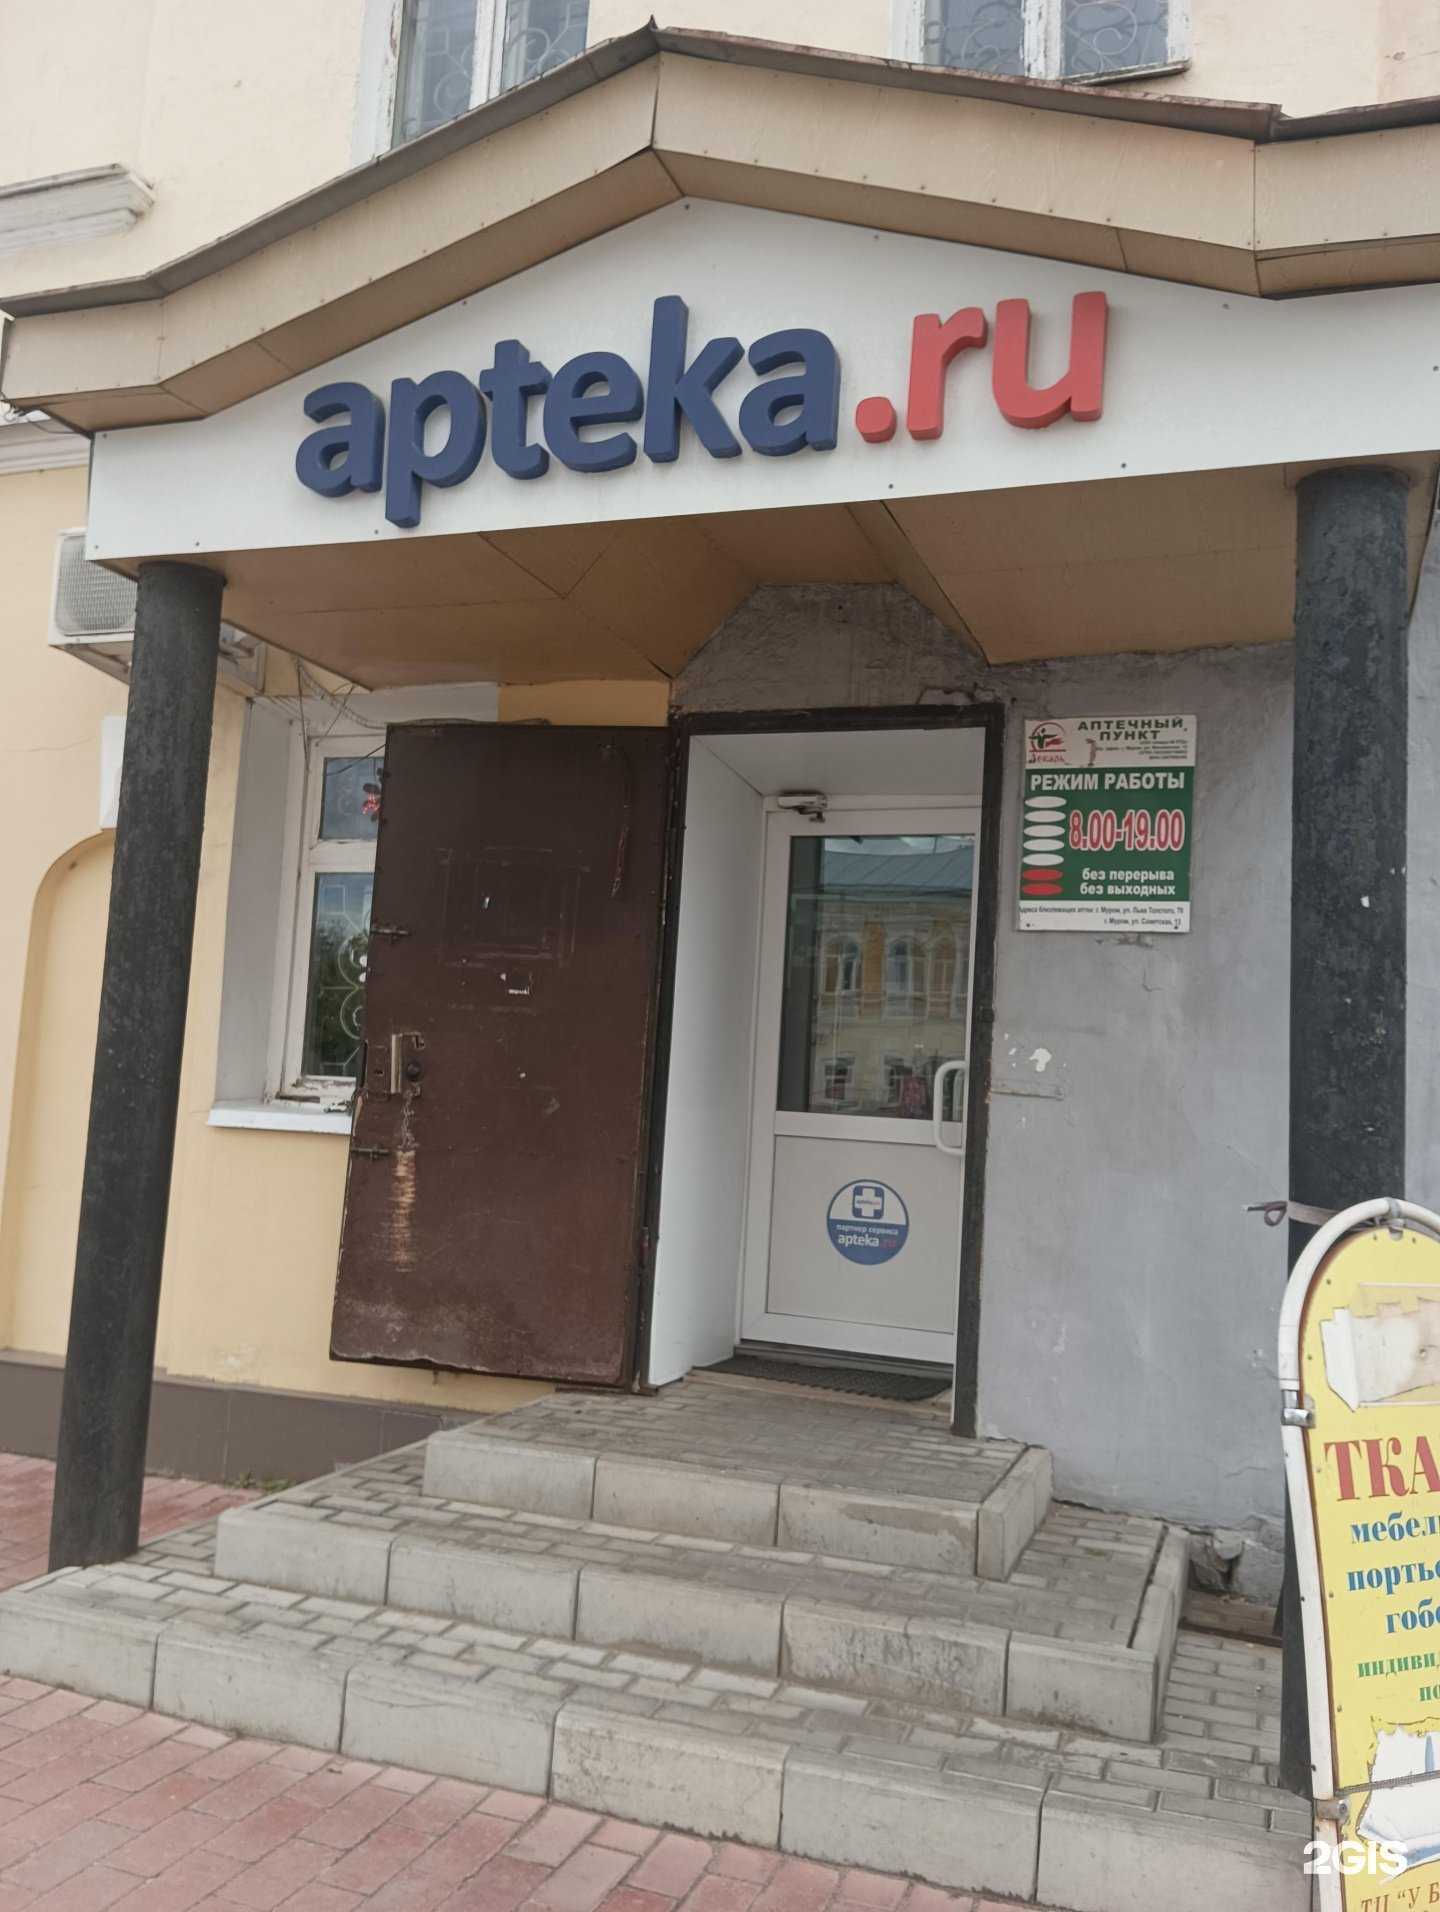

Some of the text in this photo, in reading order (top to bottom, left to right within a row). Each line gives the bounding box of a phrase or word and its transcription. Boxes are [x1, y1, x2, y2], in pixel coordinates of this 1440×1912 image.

[295, 290, 1109, 529] apteka.ru
[1078, 718, 1184, 731] АПТЕЧНЫЙ
[1100, 730, 1160, 741] ПУНКТ
[1030, 772, 1185, 791] РЕЖИМ РАБОТЫ
[1069, 809, 1185, 851] 8.00-19.00
[1082, 868, 1175, 883] без перерыва
[1080, 883, 1176, 896] без выходных
[1350, 1511, 1440, 1544] мебел
[1358, 1652, 1440, 1679] индиви
